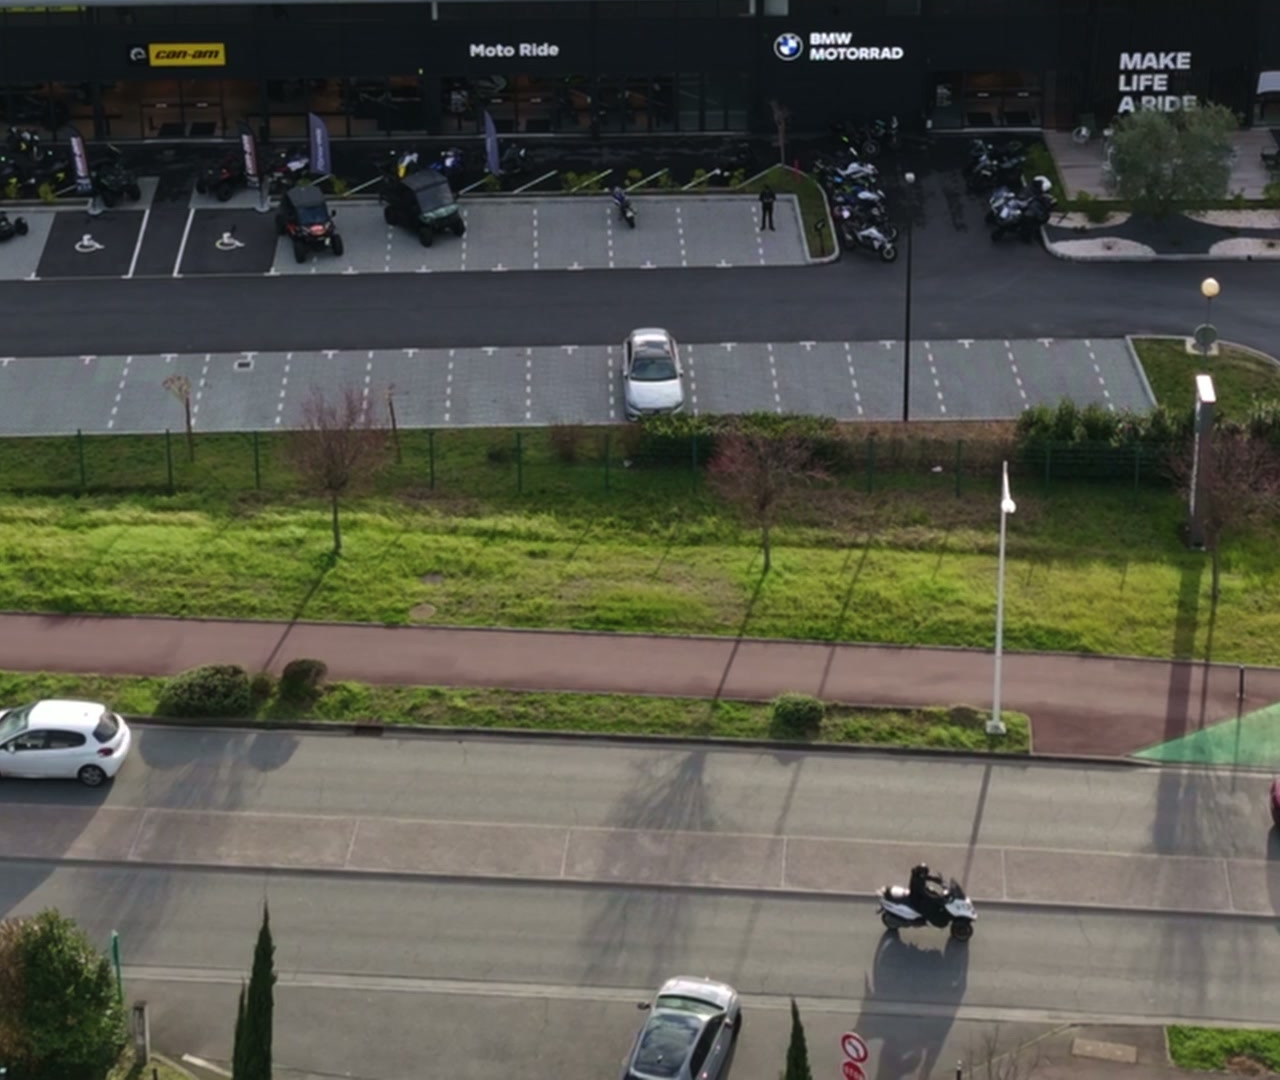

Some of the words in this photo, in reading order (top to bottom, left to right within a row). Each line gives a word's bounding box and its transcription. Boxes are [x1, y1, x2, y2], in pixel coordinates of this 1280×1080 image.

[809, 32, 852, 45] BMW
[154, 49, 220, 60] can-am
[469, 43, 515, 57] Moto
[519, 42, 559, 57] Ride
[809, 47, 904, 60] MOTORRAD
[1119, 52, 1192, 70] MAKE
[1118, 74, 1169, 91] LIFE
[1117, 95, 1136, 113] A
[1140, 94, 1198, 112] RIDE
